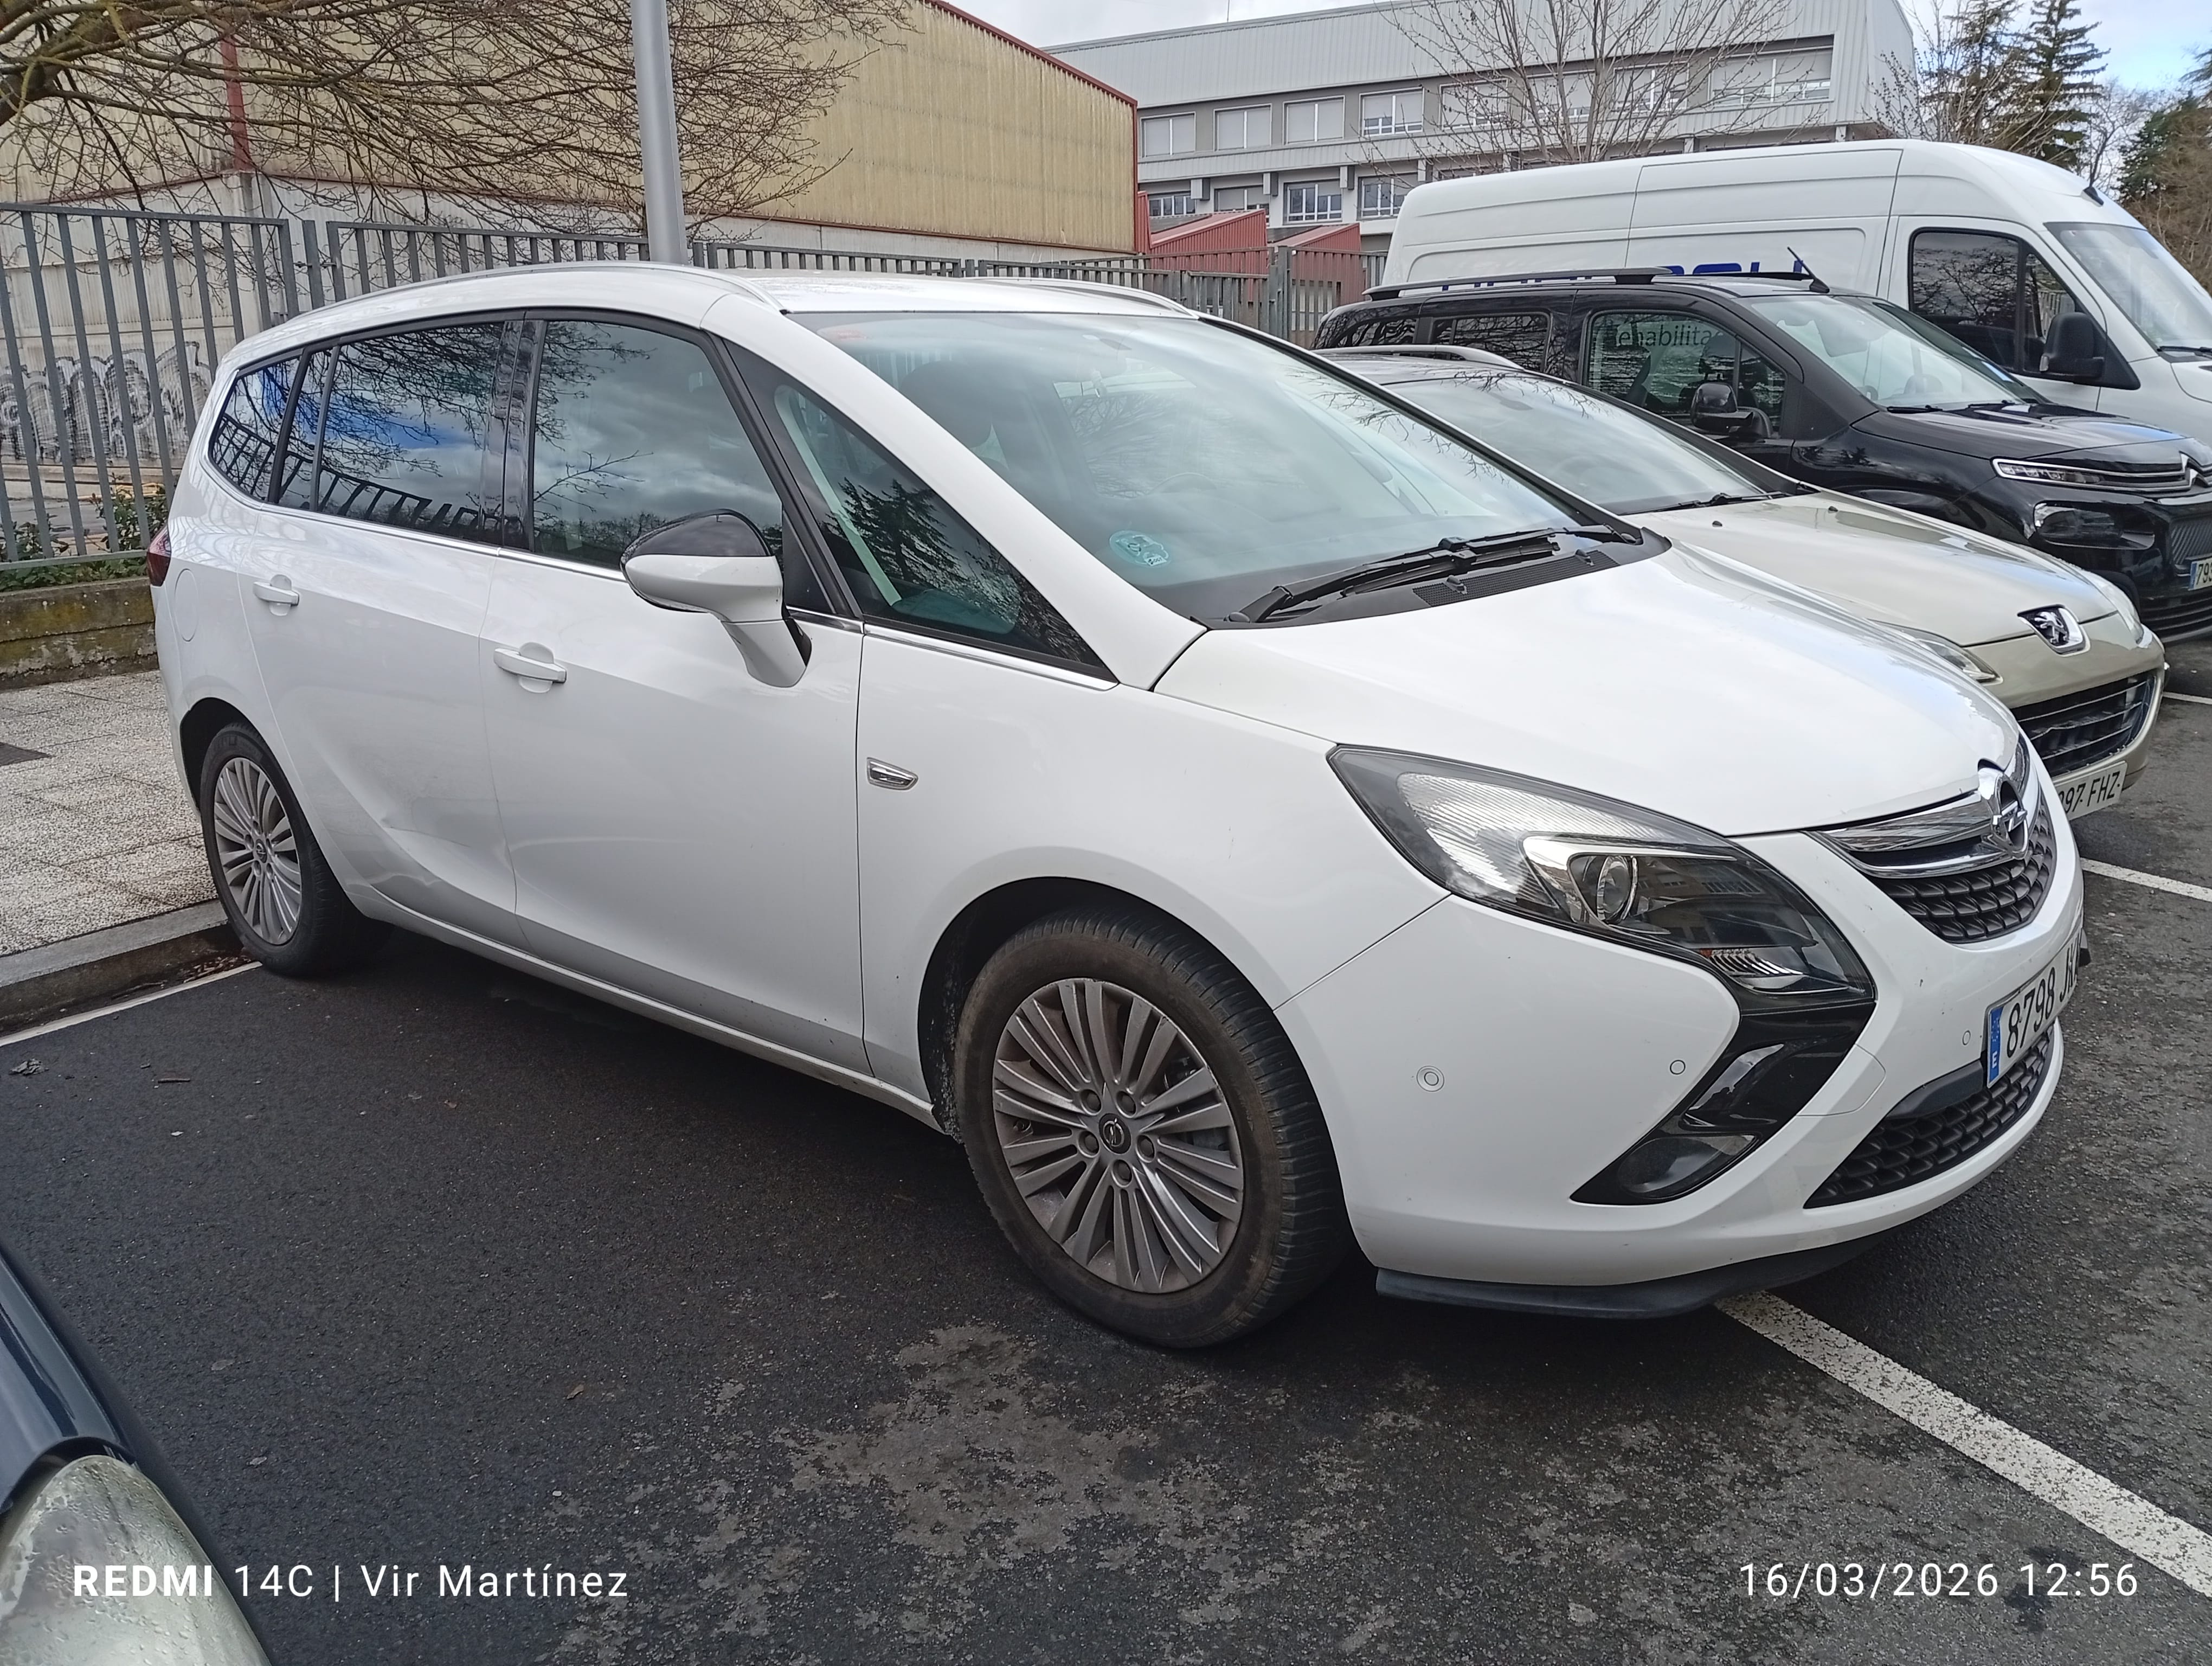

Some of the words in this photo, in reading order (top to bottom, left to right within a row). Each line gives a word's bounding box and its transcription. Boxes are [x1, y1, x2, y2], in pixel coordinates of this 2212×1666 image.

[2196, 562, 2212, 585] 79
[2087, 771, 2120, 807] FHZ
[1991, 1050, 1998, 1069] E
[2007, 967, 2056, 1059] 8798
